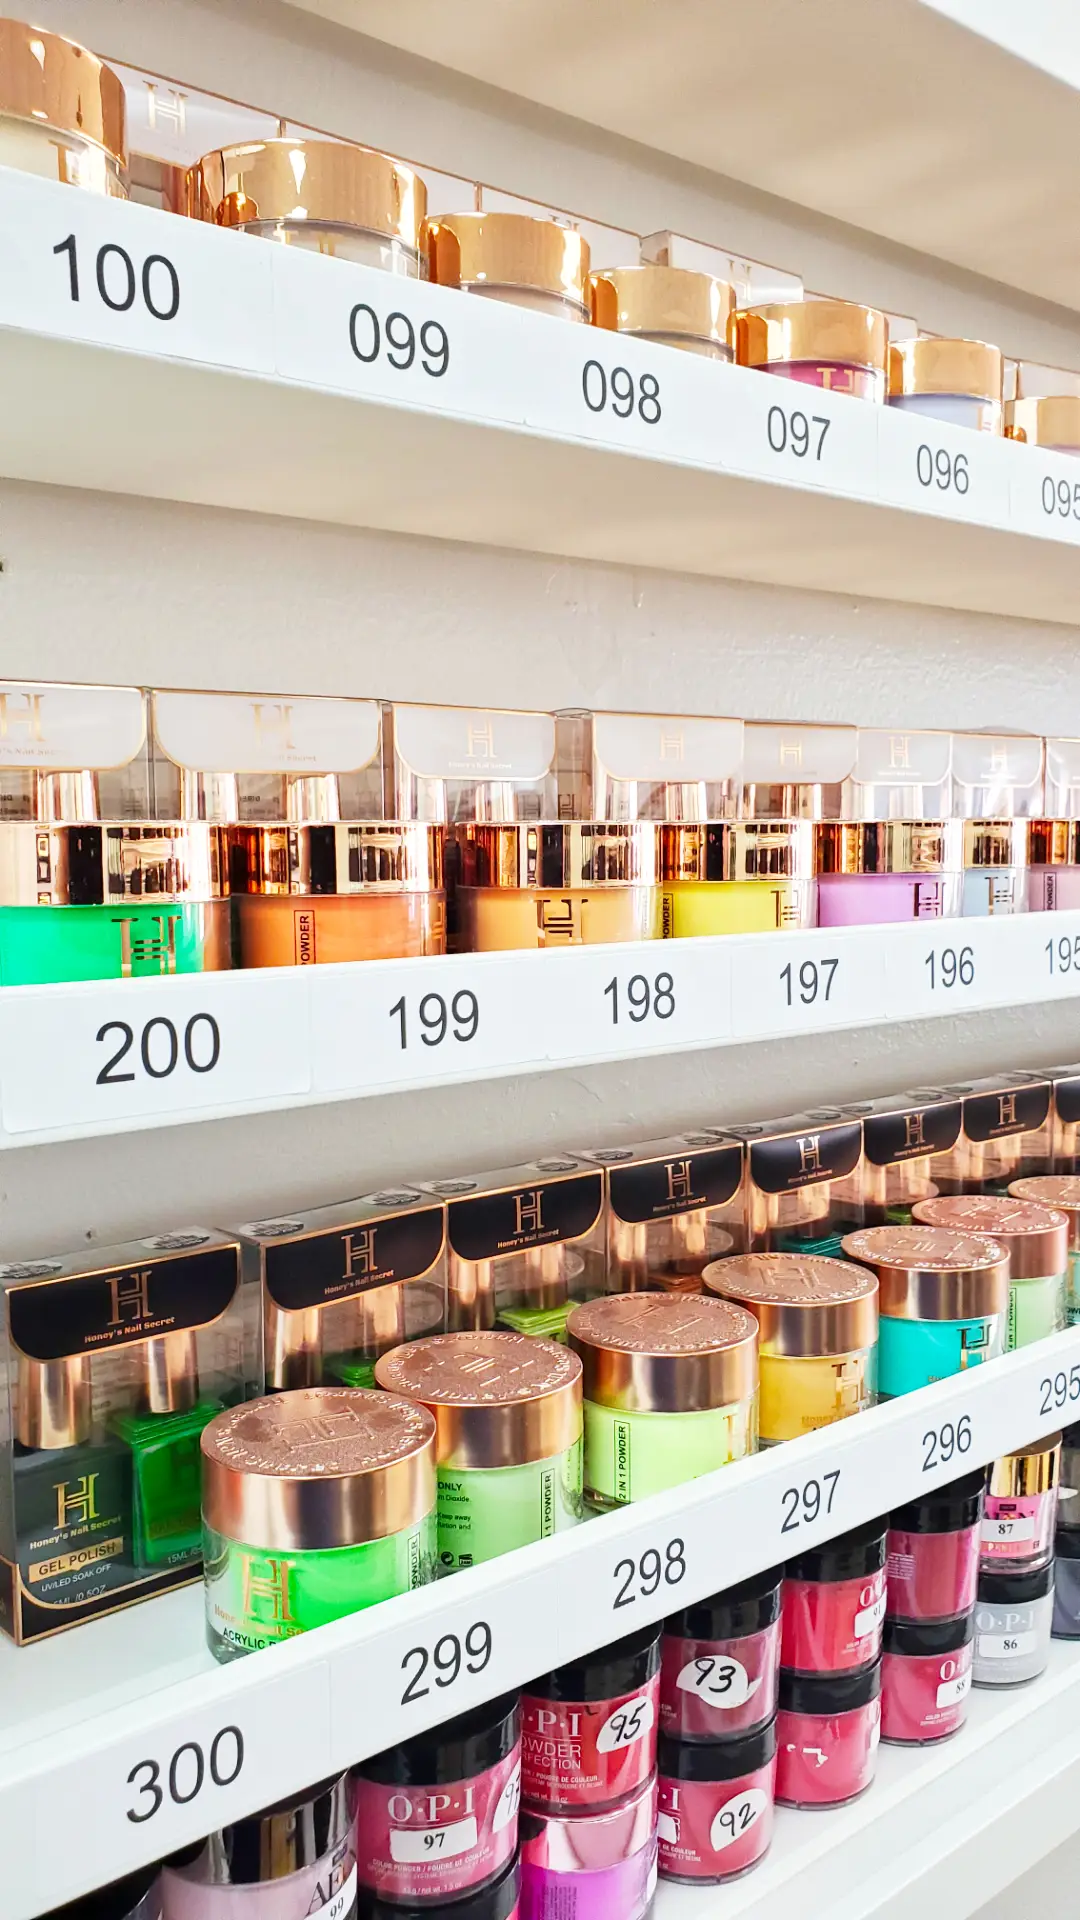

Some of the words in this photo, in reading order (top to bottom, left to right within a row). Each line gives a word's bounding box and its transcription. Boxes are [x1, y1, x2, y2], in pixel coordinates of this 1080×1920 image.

[53, 233, 180, 321] 100
[349, 303, 450, 377] 099
[582, 359, 662, 424] 098
[767, 406, 830, 460] 097
[917, 444, 969, 495] 096
[1042, 476, 1080, 521] 095
[925, 945, 975, 990] 196
[1045, 936, 1080, 975] 195
[603, 971, 676, 1025] 198
[779, 957, 839, 1007] 197
[388, 988, 480, 1050] 199
[95, 1012, 221, 1086] 200
[903, 1112, 926, 1147] H
[997, 1093, 1017, 1125] H
[796, 1135, 823, 1173] H
[664, 1160, 694, 1200] H
[511, 1190, 545, 1235] H
[341, 1228, 378, 1279] H
[104, 1270, 154, 1326] H
[84, 1329, 123, 1344] Honey's
[124, 1323, 142, 1335] Nail
[143, 1316, 176, 1330] Secret
[1039, 1364, 1080, 1416] 295
[618, 1426, 626, 1471] POWDER
[921, 1413, 972, 1473] 296
[53, 1472, 100, 1531] H
[544, 1474, 552, 1522] POWDER
[619, 1481, 626, 1491] IN
[780, 1469, 841, 1534] 297
[29, 1533, 69, 1550] Honey's
[70, 1526, 90, 1538] Nail
[90, 1515, 122, 1530] Secret
[998, 1523, 1014, 1535] 87
[38, 1560, 66, 1577] GEL
[69, 1541, 117, 1566] POLISH
[41, 1577, 71, 1592] UV/LED
[72, 1569, 95, 1583] SOAK
[95, 1563, 113, 1575] OFF
[611, 1537, 687, 1610] 298
[237, 1552, 297, 1622] H
[223, 1627, 266, 1650] ACRYLIC
[1003, 1638, 1018, 1650] 86
[400, 1620, 493, 1706] 299
[694, 1657, 737, 1693] 93
[610, 1701, 647, 1745] 95
[521, 1735, 582, 1758] OWDER
[125, 1724, 245, 1825] 300
[423, 1832, 446, 1851] 97
[719, 1802, 757, 1837] 92
